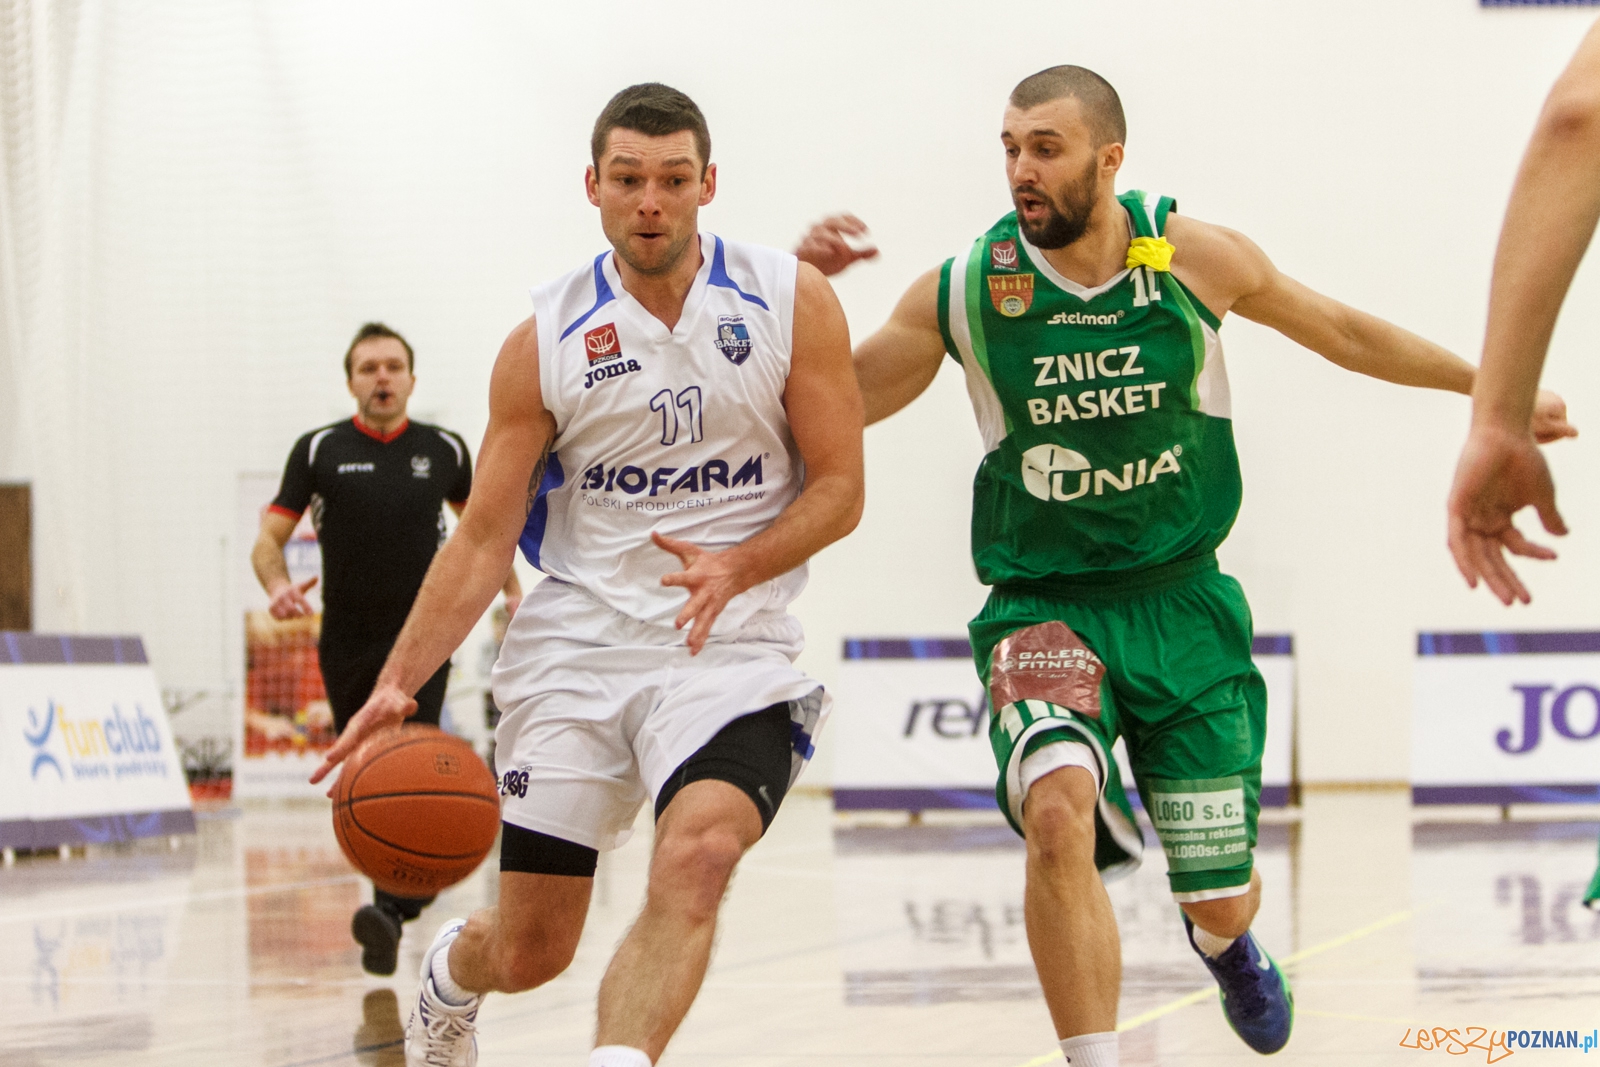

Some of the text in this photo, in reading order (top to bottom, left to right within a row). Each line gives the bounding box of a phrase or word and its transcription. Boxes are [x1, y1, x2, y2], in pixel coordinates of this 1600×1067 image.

[1047, 311, 1118, 325] stelman
[1033, 345, 1144, 387] ZNICZ
[1027, 382, 1167, 425] BASKET
[649, 385, 704, 446] 11
[580, 453, 763, 497] BIOFARM
[1051, 449, 1182, 501] UNIA
[582, 493, 621, 510] POLSKI
[626, 497, 713, 512] PRODUCENT
[1018, 648, 1102, 665] GALERIA
[1018, 660, 1097, 675] FITNESS
[1155, 800, 1195, 822] LOGO
[1208, 826, 1246, 840] reklama
